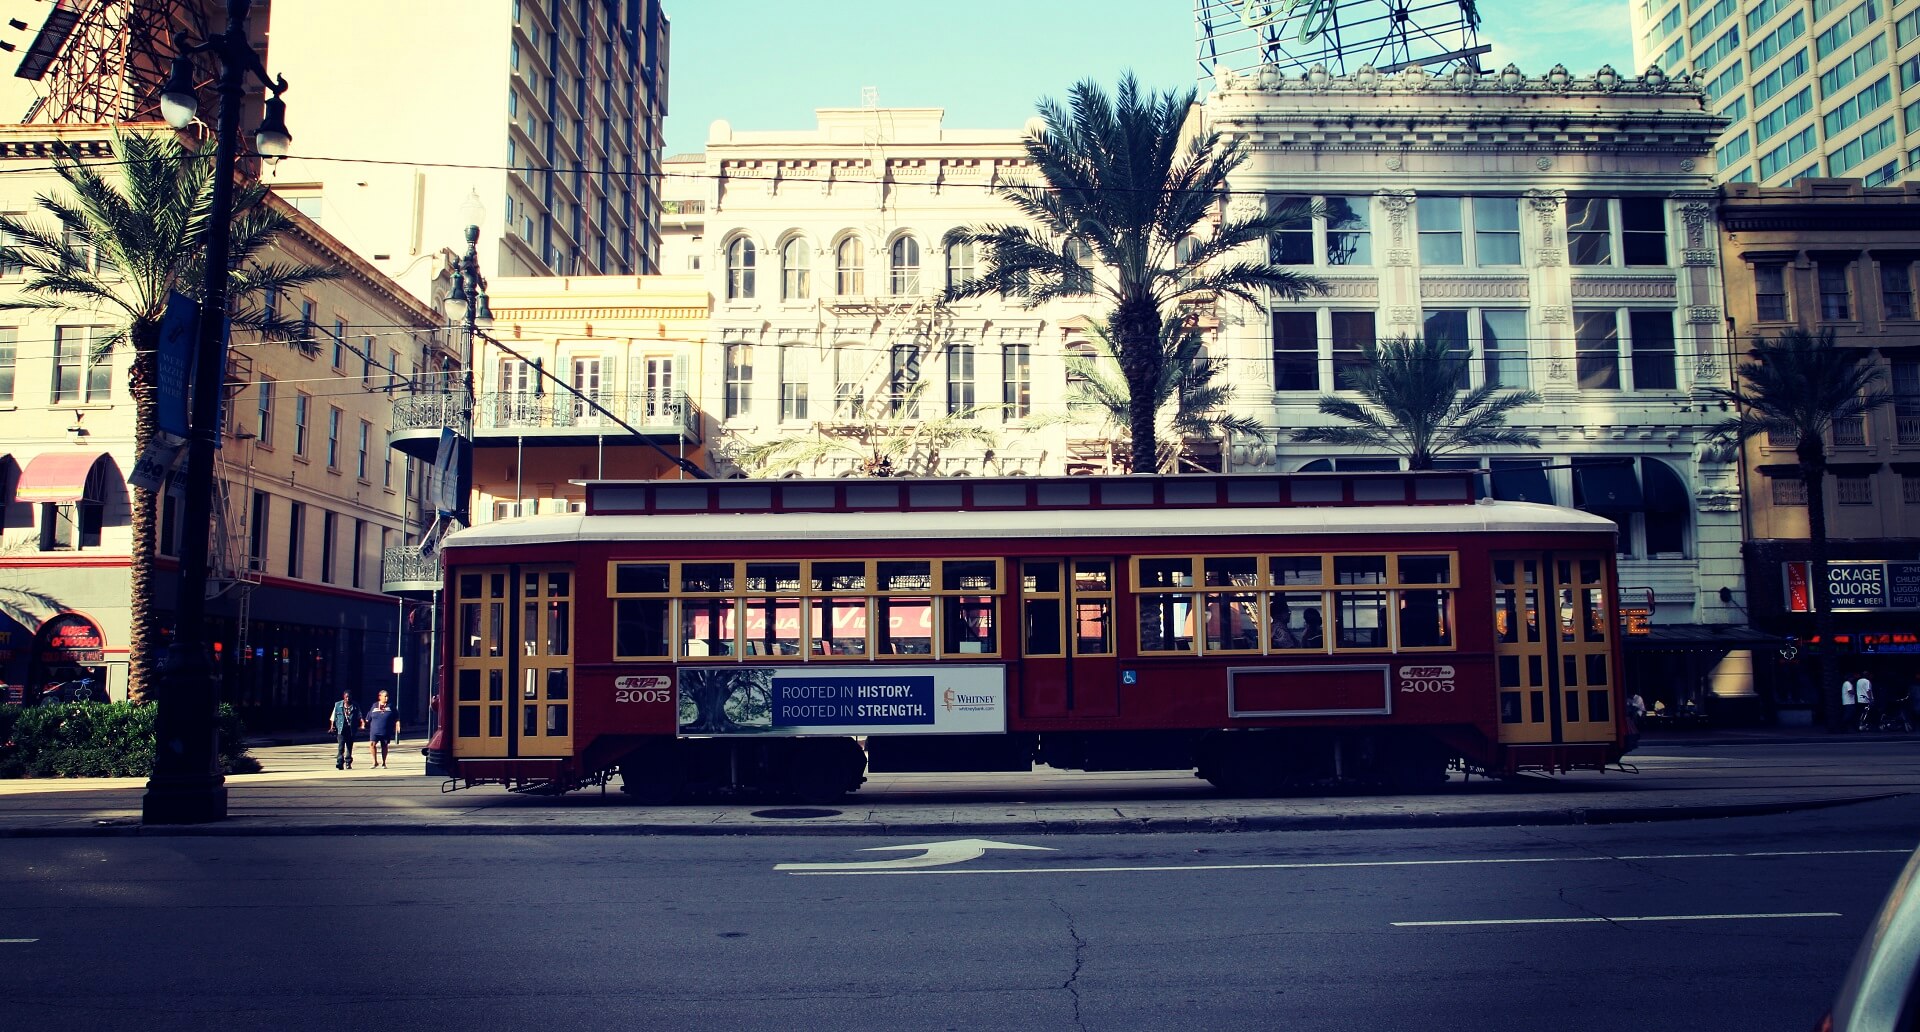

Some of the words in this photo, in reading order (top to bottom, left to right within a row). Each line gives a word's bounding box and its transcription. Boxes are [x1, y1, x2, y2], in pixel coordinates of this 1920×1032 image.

[1827, 568, 1881, 581] CKAGE
[1829, 583, 1881, 595] QUORS
[725, 608, 803, 630] CANA
[831, 607, 904, 629] VIDO
[1410, 667, 1443, 678] RTA
[782, 686, 836, 699] ROOTED
[840, 686, 854, 698] IN
[857, 685, 913, 698] HISTORY.
[1400, 680, 1455, 693] 2005
[616, 690, 671, 703] 2005
[957, 694, 994, 704] WHITNEY
[782, 705, 836, 718] ROOTED
[840, 705, 854, 717] IN
[857, 704, 926, 717] STRENGTH.
